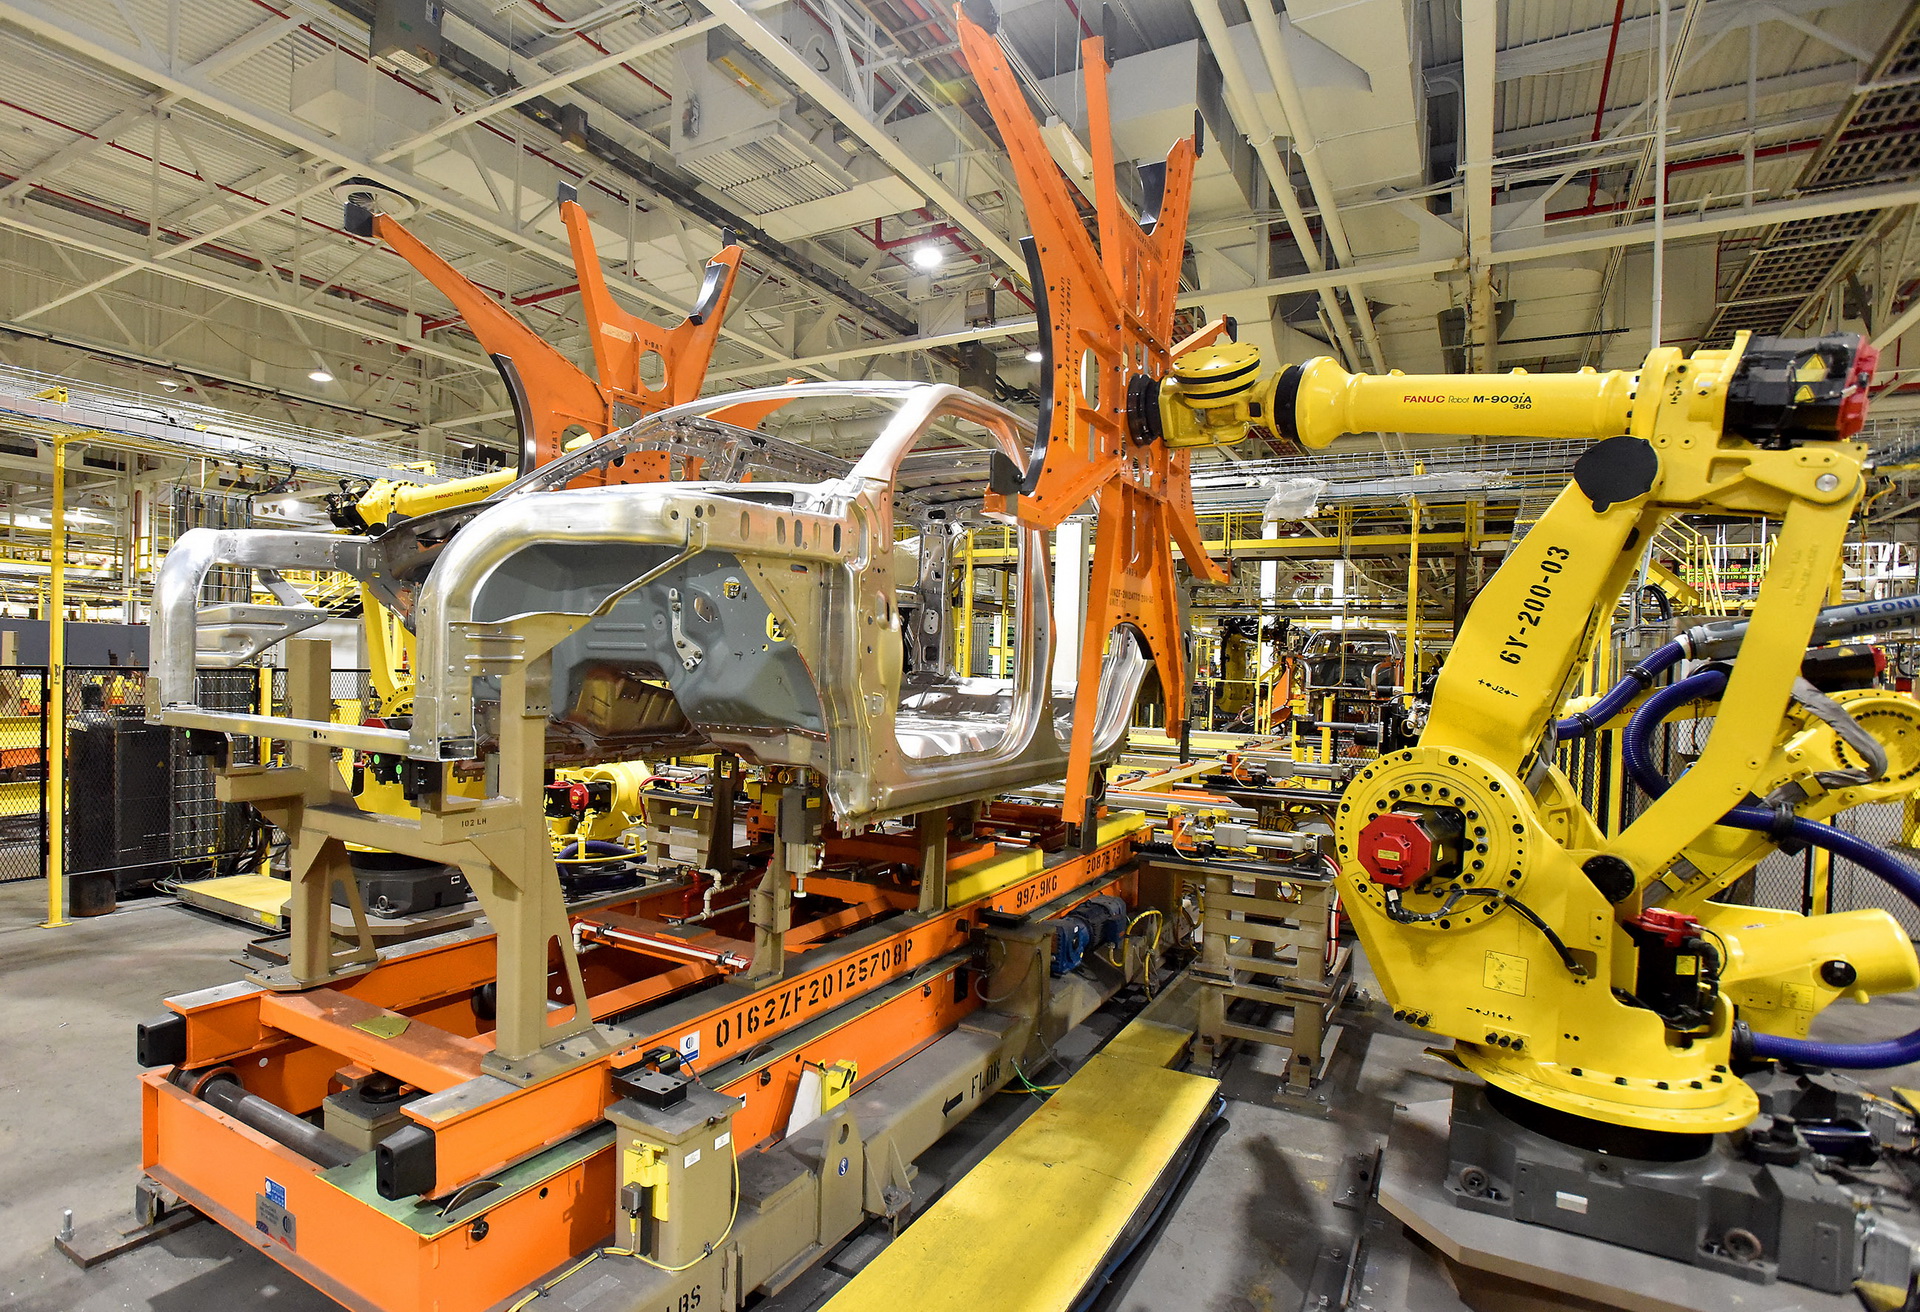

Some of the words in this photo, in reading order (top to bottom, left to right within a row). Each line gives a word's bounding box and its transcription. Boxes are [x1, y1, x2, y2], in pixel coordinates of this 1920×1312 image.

[1403, 395, 1445, 403] FANUC
[1448, 395, 1470, 403] Robot
[1473, 392, 1532, 403] M-900iA
[1500, 546, 1570, 665] 6Y-200-03
[1855, 598, 1920, 616] LEONI
[461, 819, 475, 827] 102
[477, 817, 487, 826] LH
[1016, 875, 1058, 908] 997.9KG
[716, 938, 913, 1048] 0162ZF20125708P
[666, 1284, 701, 1312] BS
